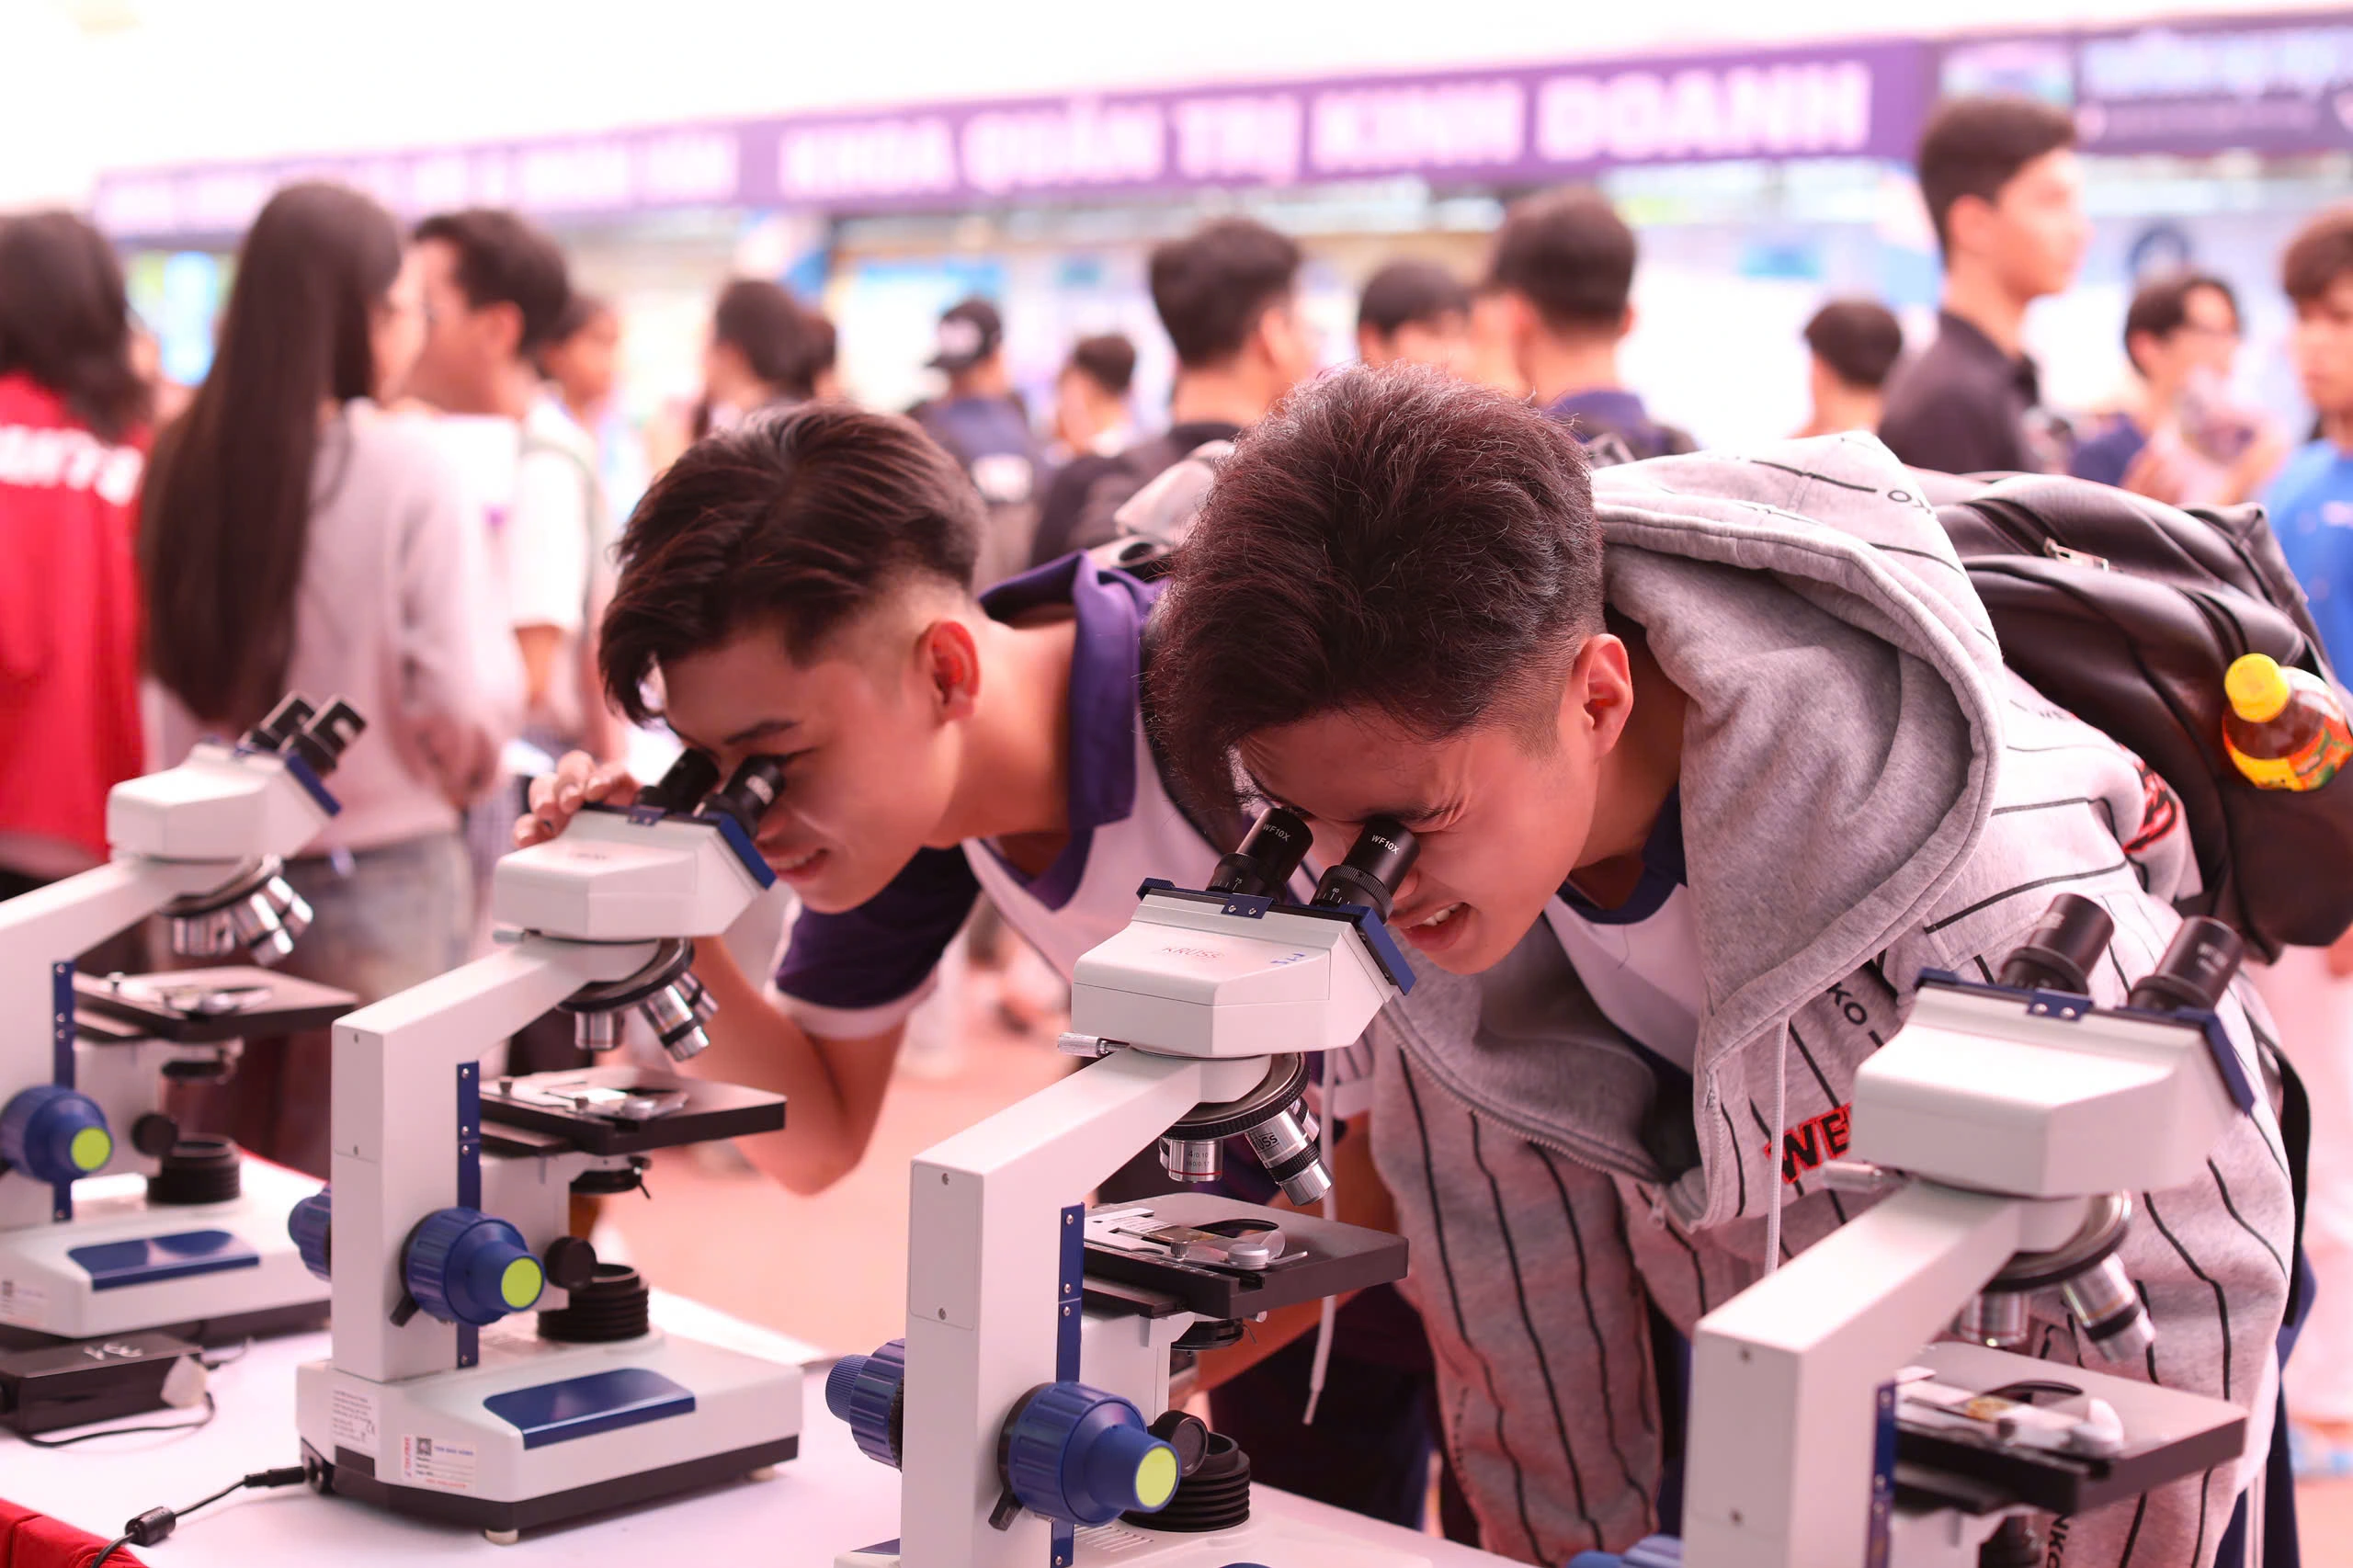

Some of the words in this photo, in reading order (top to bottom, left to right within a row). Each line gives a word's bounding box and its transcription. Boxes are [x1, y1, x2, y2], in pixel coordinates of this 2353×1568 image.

[1536, 62, 1872, 161] DOANH
[1263, 823, 1292, 843] WF10X
[1370, 835, 1400, 855] WF10X
